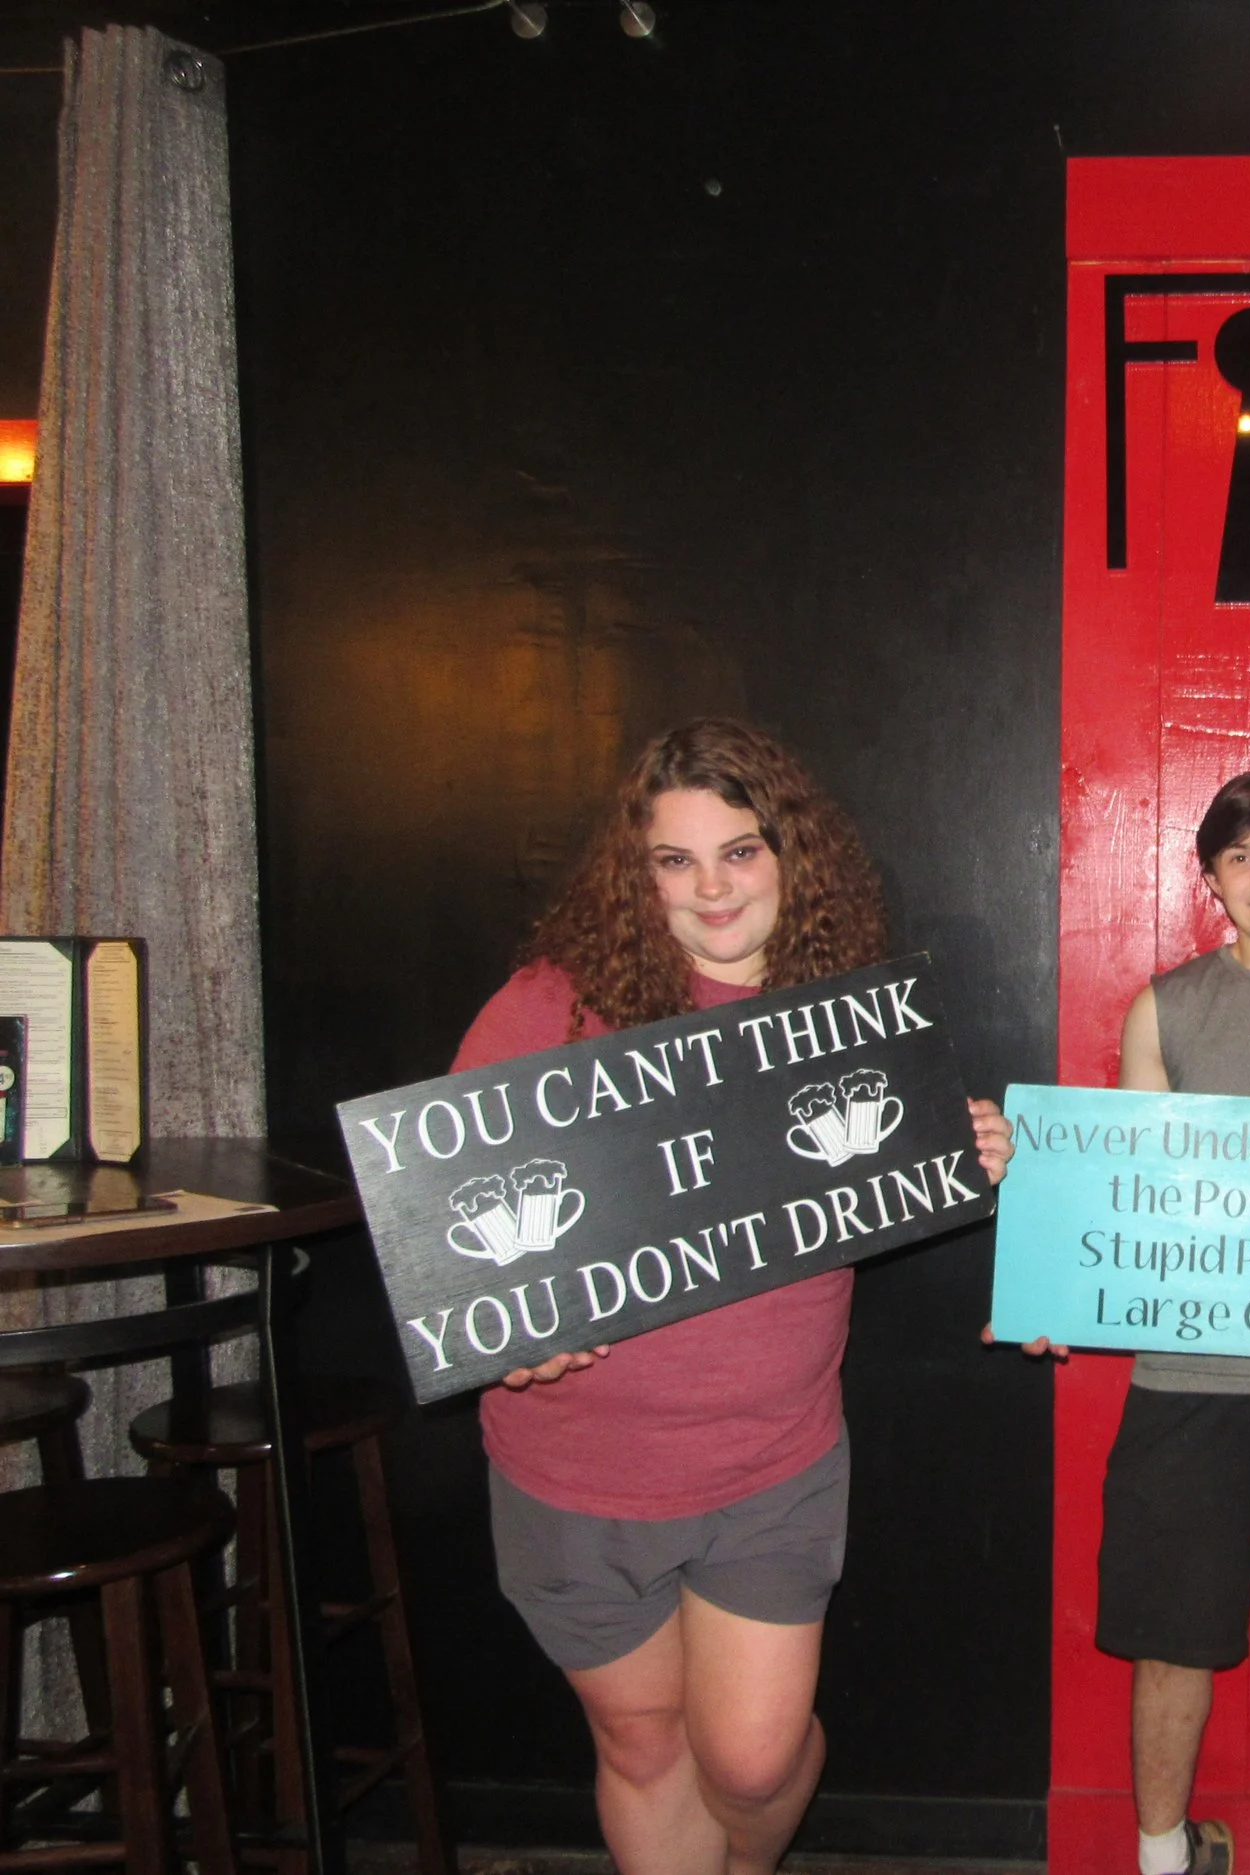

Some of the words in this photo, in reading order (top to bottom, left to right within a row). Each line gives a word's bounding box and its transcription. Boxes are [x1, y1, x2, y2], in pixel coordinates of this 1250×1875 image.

[360, 1083, 514, 1175] YOU
[534, 1029, 724, 1130] CAN'T
[739, 978, 934, 1073] THINK
[1015, 1113, 1152, 1157] Never
[657, 1129, 716, 1197] IF
[1108, 1173, 1182, 1216] the
[406, 1277, 561, 1373] YOU
[577, 1212, 769, 1321] DON'T
[782, 1150, 981, 1258] DRINK
[1079, 1230, 1226, 1282] Stupid
[1096, 1287, 1231, 1340] Large
